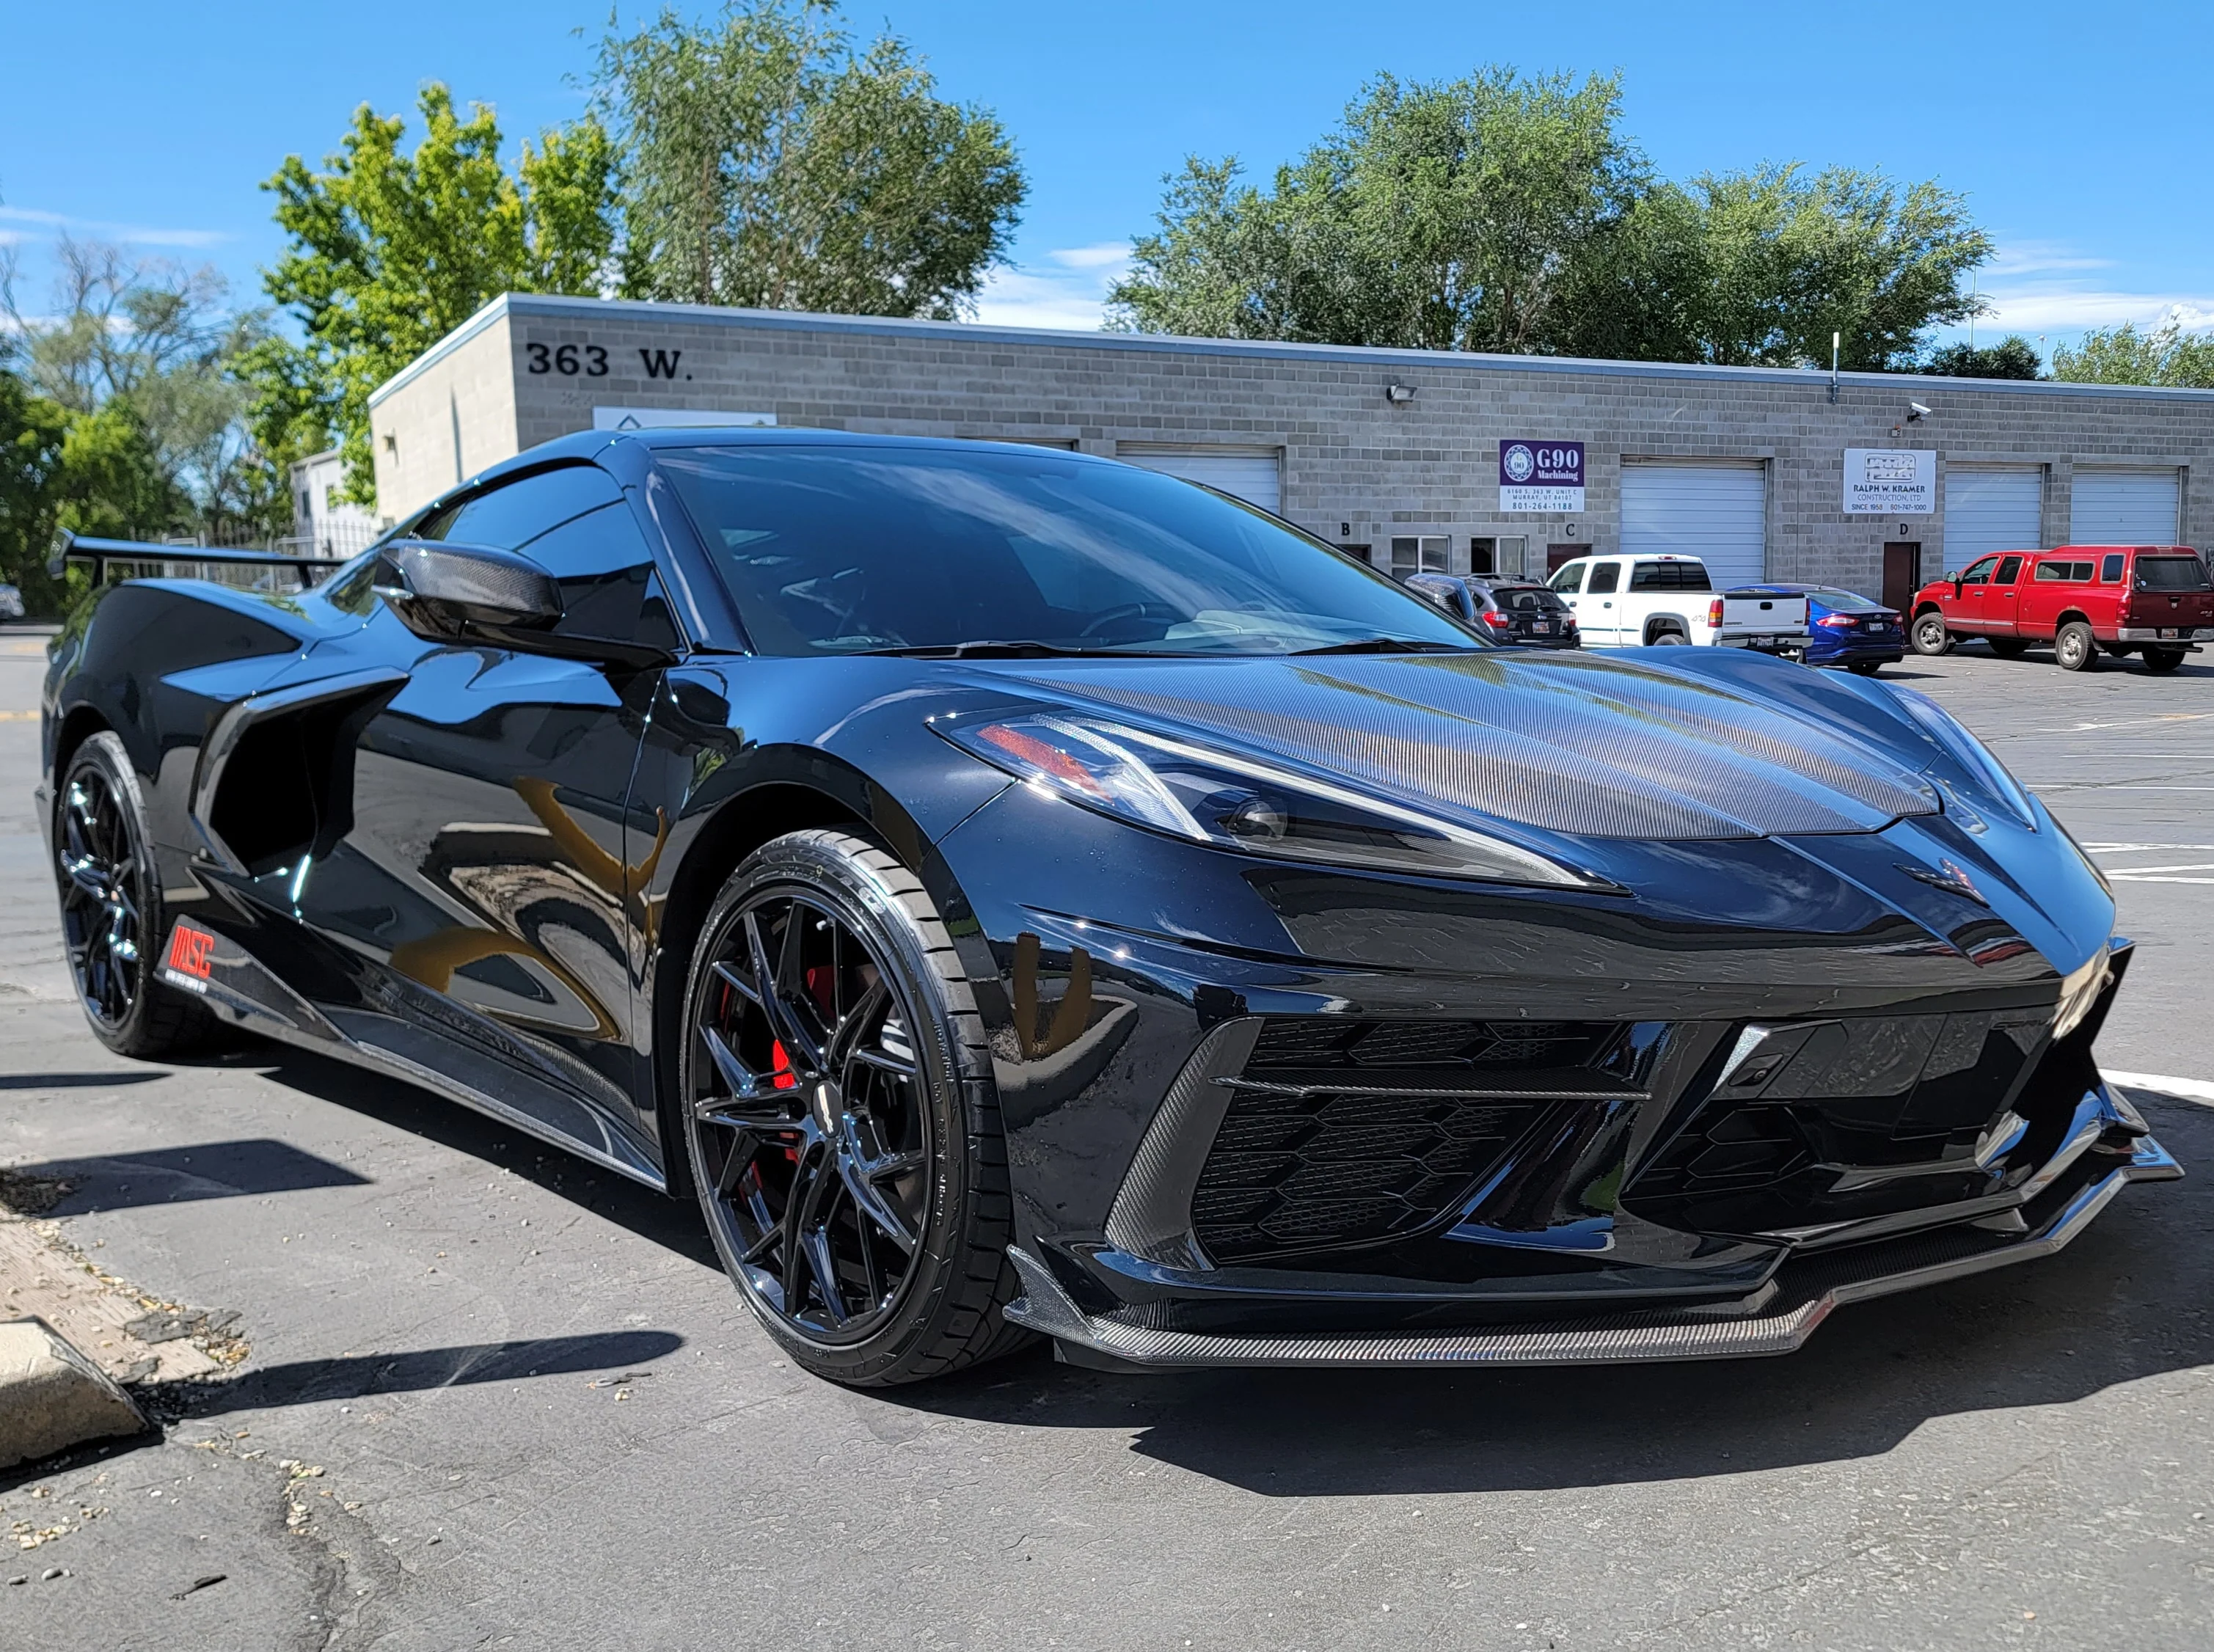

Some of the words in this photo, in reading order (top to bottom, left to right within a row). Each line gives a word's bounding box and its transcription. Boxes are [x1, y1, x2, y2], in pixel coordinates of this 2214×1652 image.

[526, 343, 609, 377] 363
[638, 348, 693, 381] W.
[1537, 448, 1579, 469] G90
[1514, 461, 1524, 469] 90
[1537, 469, 1579, 482] Machining
[1853, 484, 1879, 492] RALPH
[1892, 485, 1926, 493] KRAMER
[1512, 502, 1573, 510] 801-264-1188
[1341, 522, 1351, 536] B
[1565, 524, 1575, 536] C
[1899, 523, 1909, 535] D
